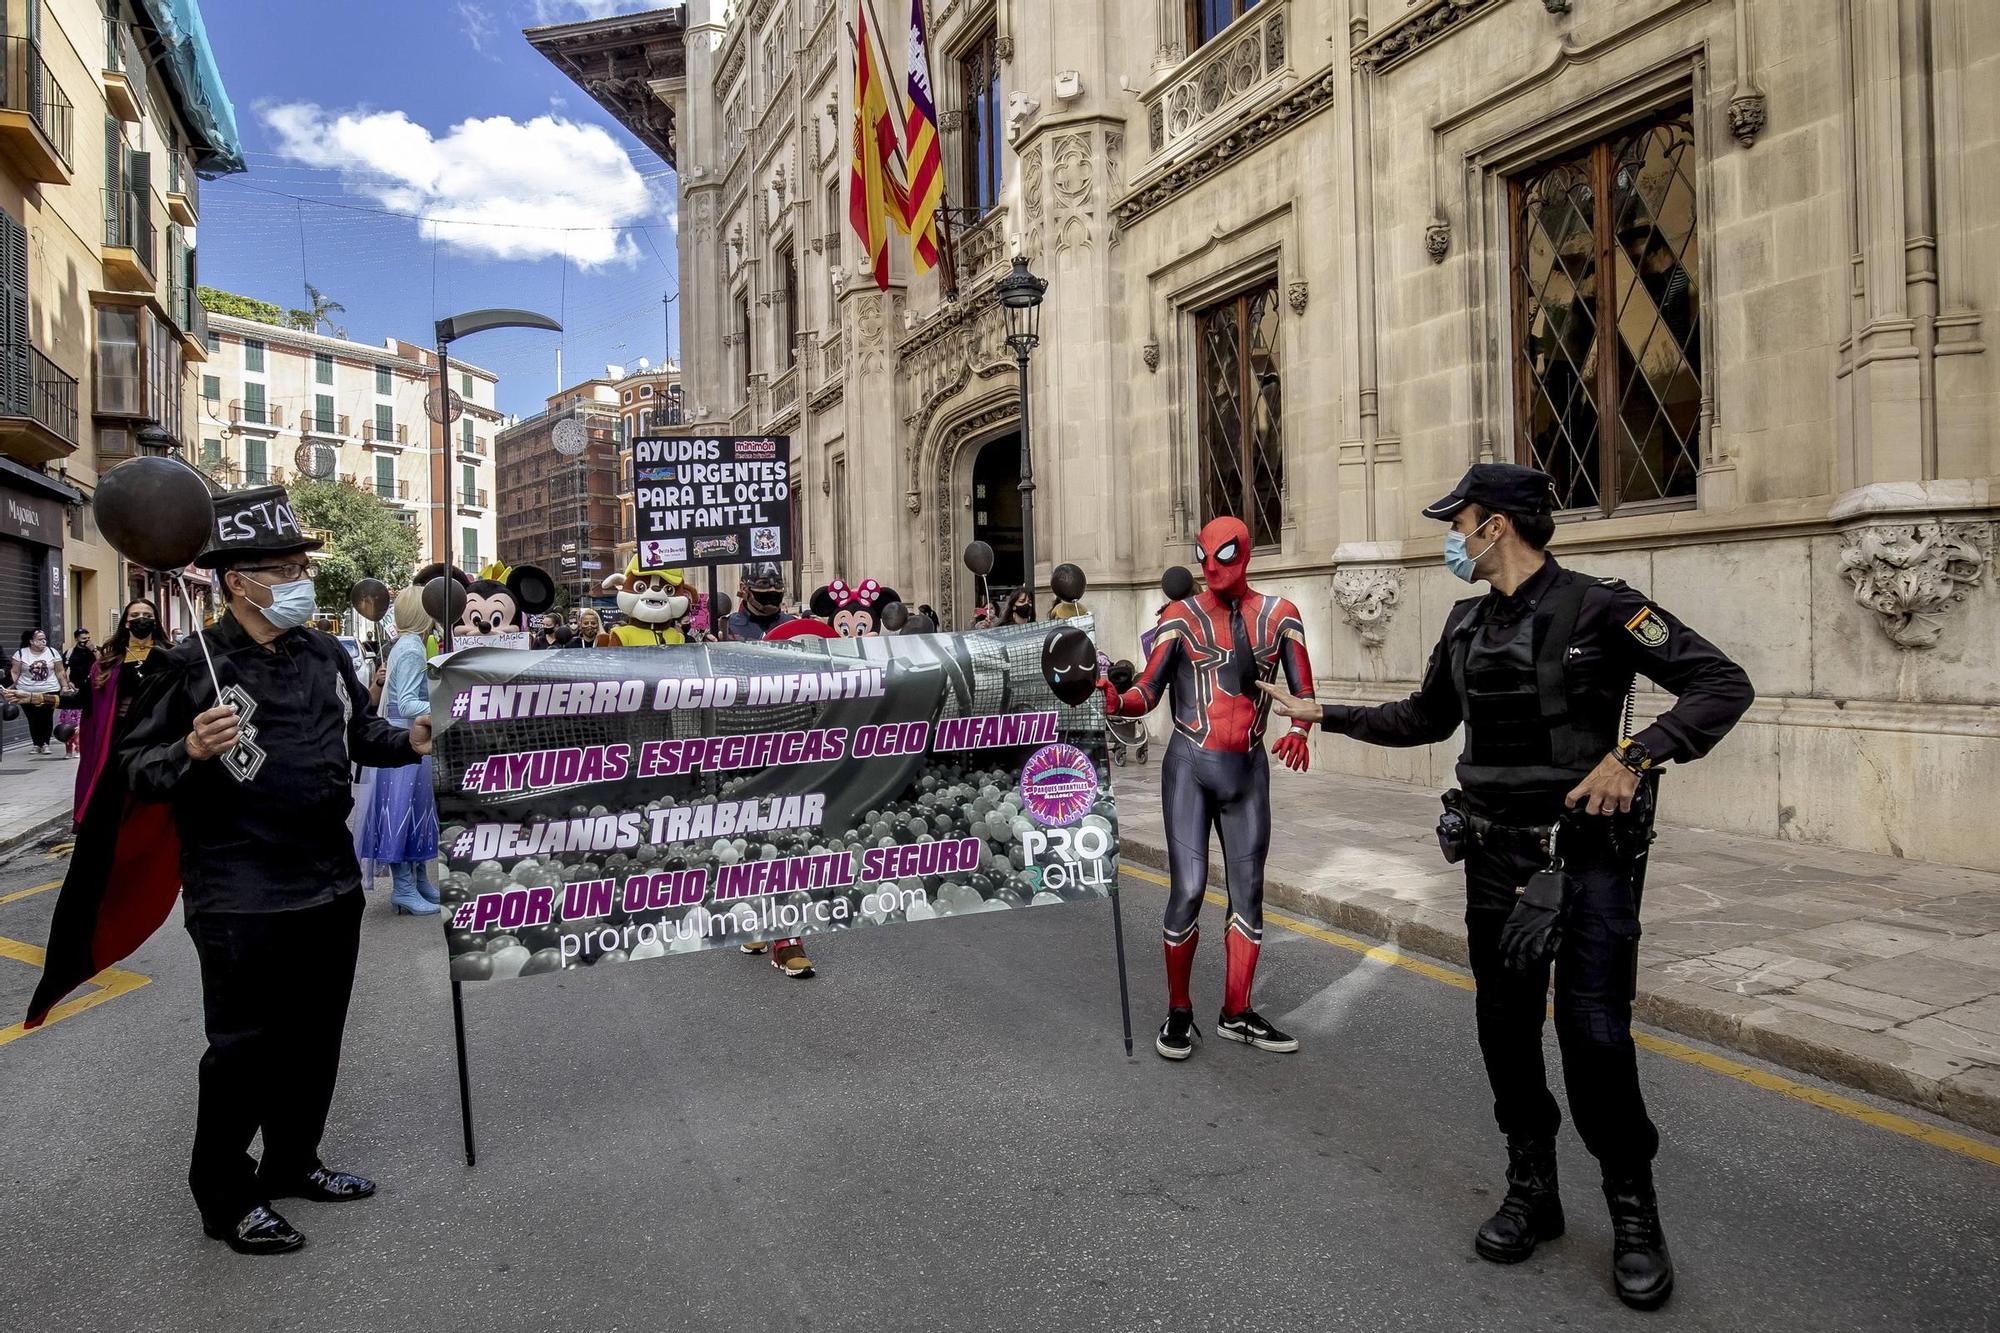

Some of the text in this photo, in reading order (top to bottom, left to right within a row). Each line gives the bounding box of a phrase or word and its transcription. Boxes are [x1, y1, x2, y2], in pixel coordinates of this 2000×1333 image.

[636, 440, 720, 462] AYUDAS
[677, 461, 787, 485] URGENTES
[637, 482, 788, 509] PARA EL OCIO
[650, 504, 769, 532] INFANTIL
[452, 669, 886, 722] #ENTIERRO OCIO INFANTIL
[462, 711, 1060, 794] #AYUDAS ESPECIFICAS OCIO INFANTIL
[453, 793, 825, 861] #DEJANOS TRABAJAR
[1022, 825, 1108, 867] PRO
[453, 836, 980, 933] #POR UN OCIO INFANTIL SEGURO
[1024, 858, 1113, 892] ROTUL
[559, 886, 927, 969] prorotulmallorca.com
